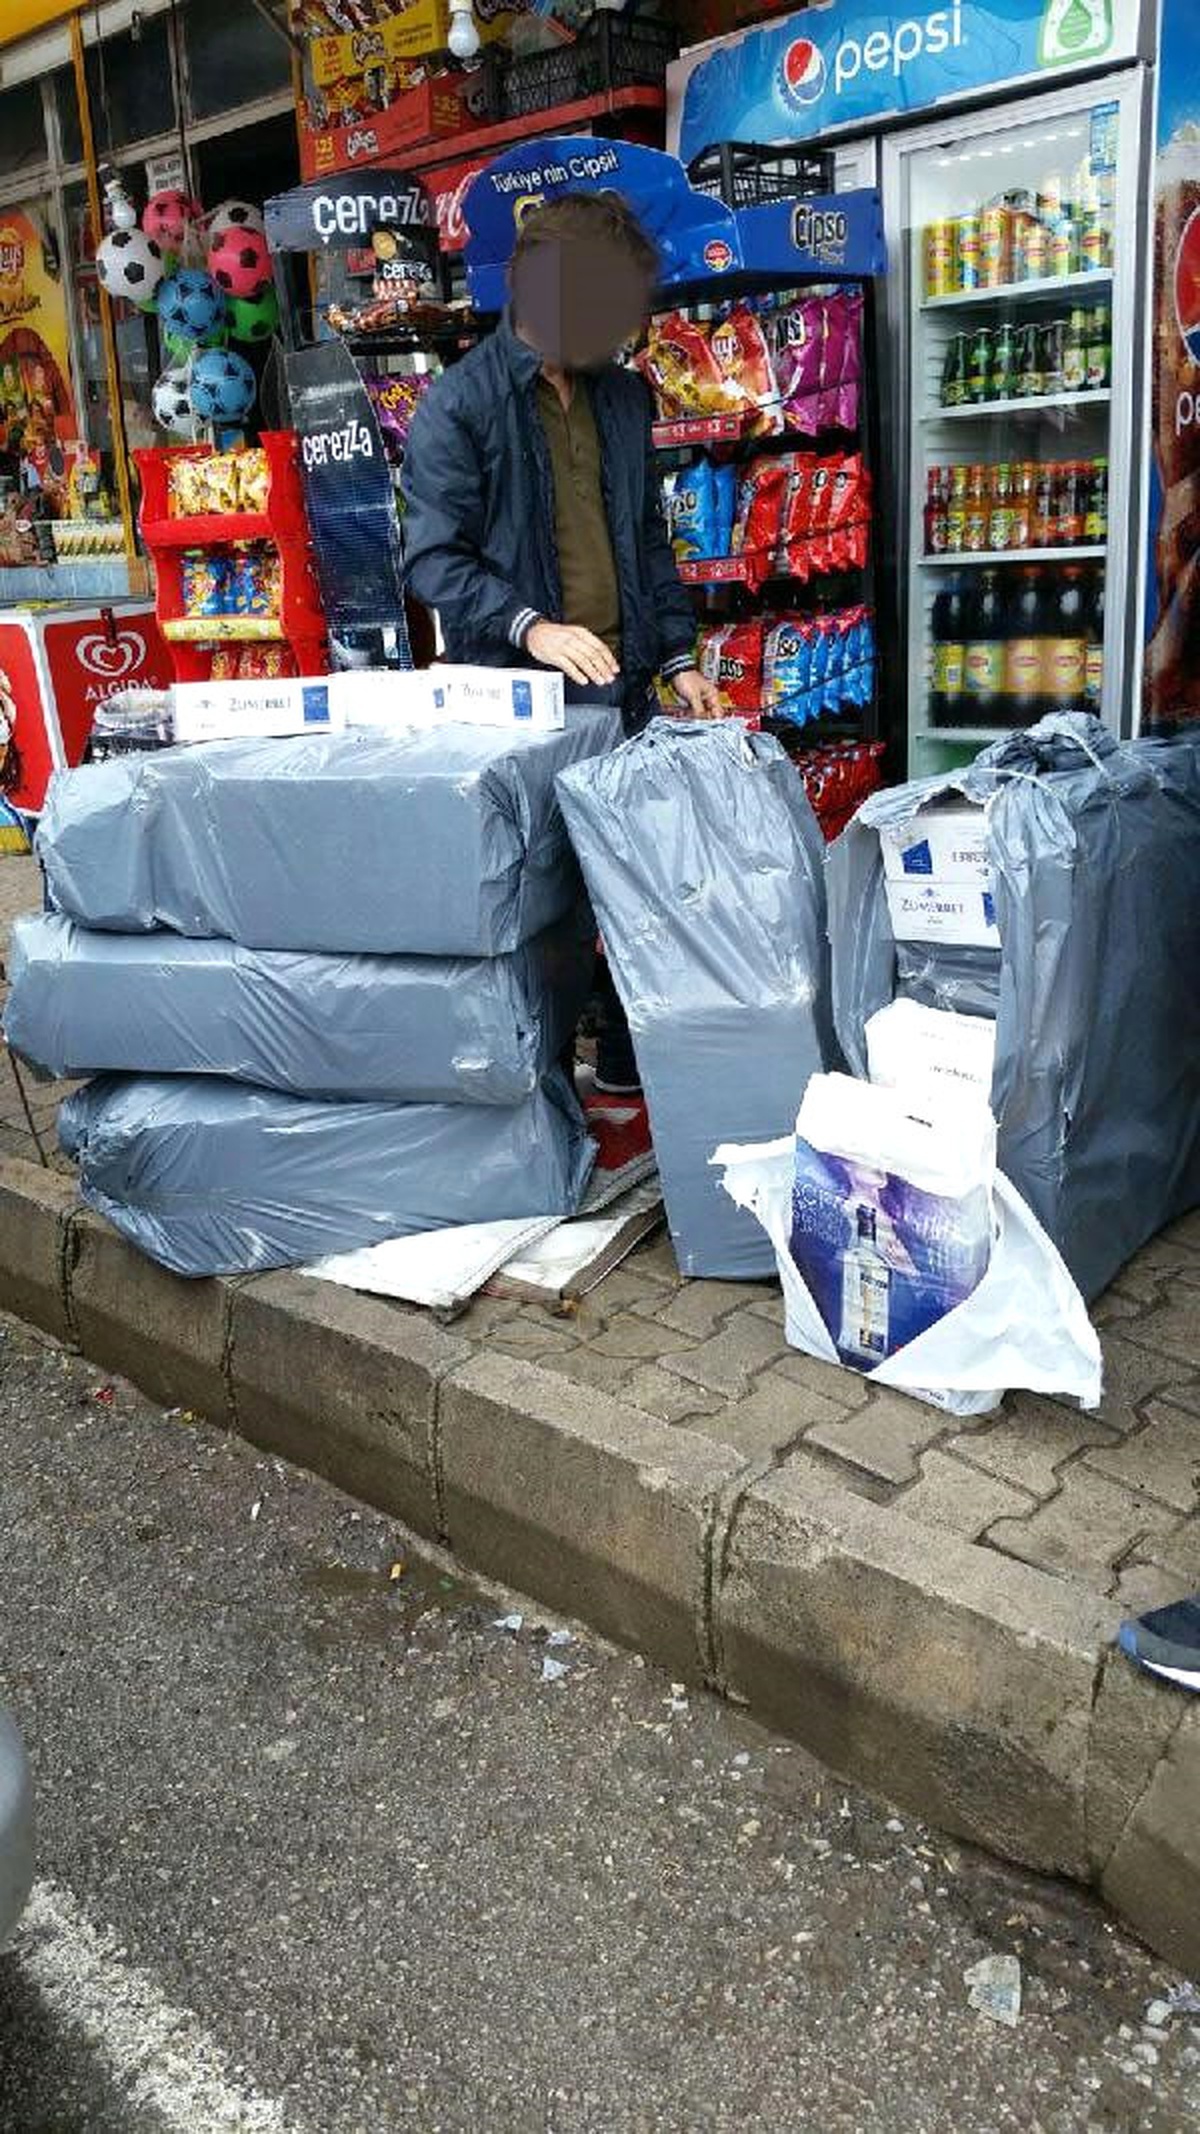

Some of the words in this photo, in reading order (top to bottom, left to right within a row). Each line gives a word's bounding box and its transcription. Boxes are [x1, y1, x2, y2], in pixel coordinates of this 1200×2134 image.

[834, 0, 962, 94] pepsi
[792, 205, 848, 256] Cipso
[85, 677, 152, 702] ALGIDA
